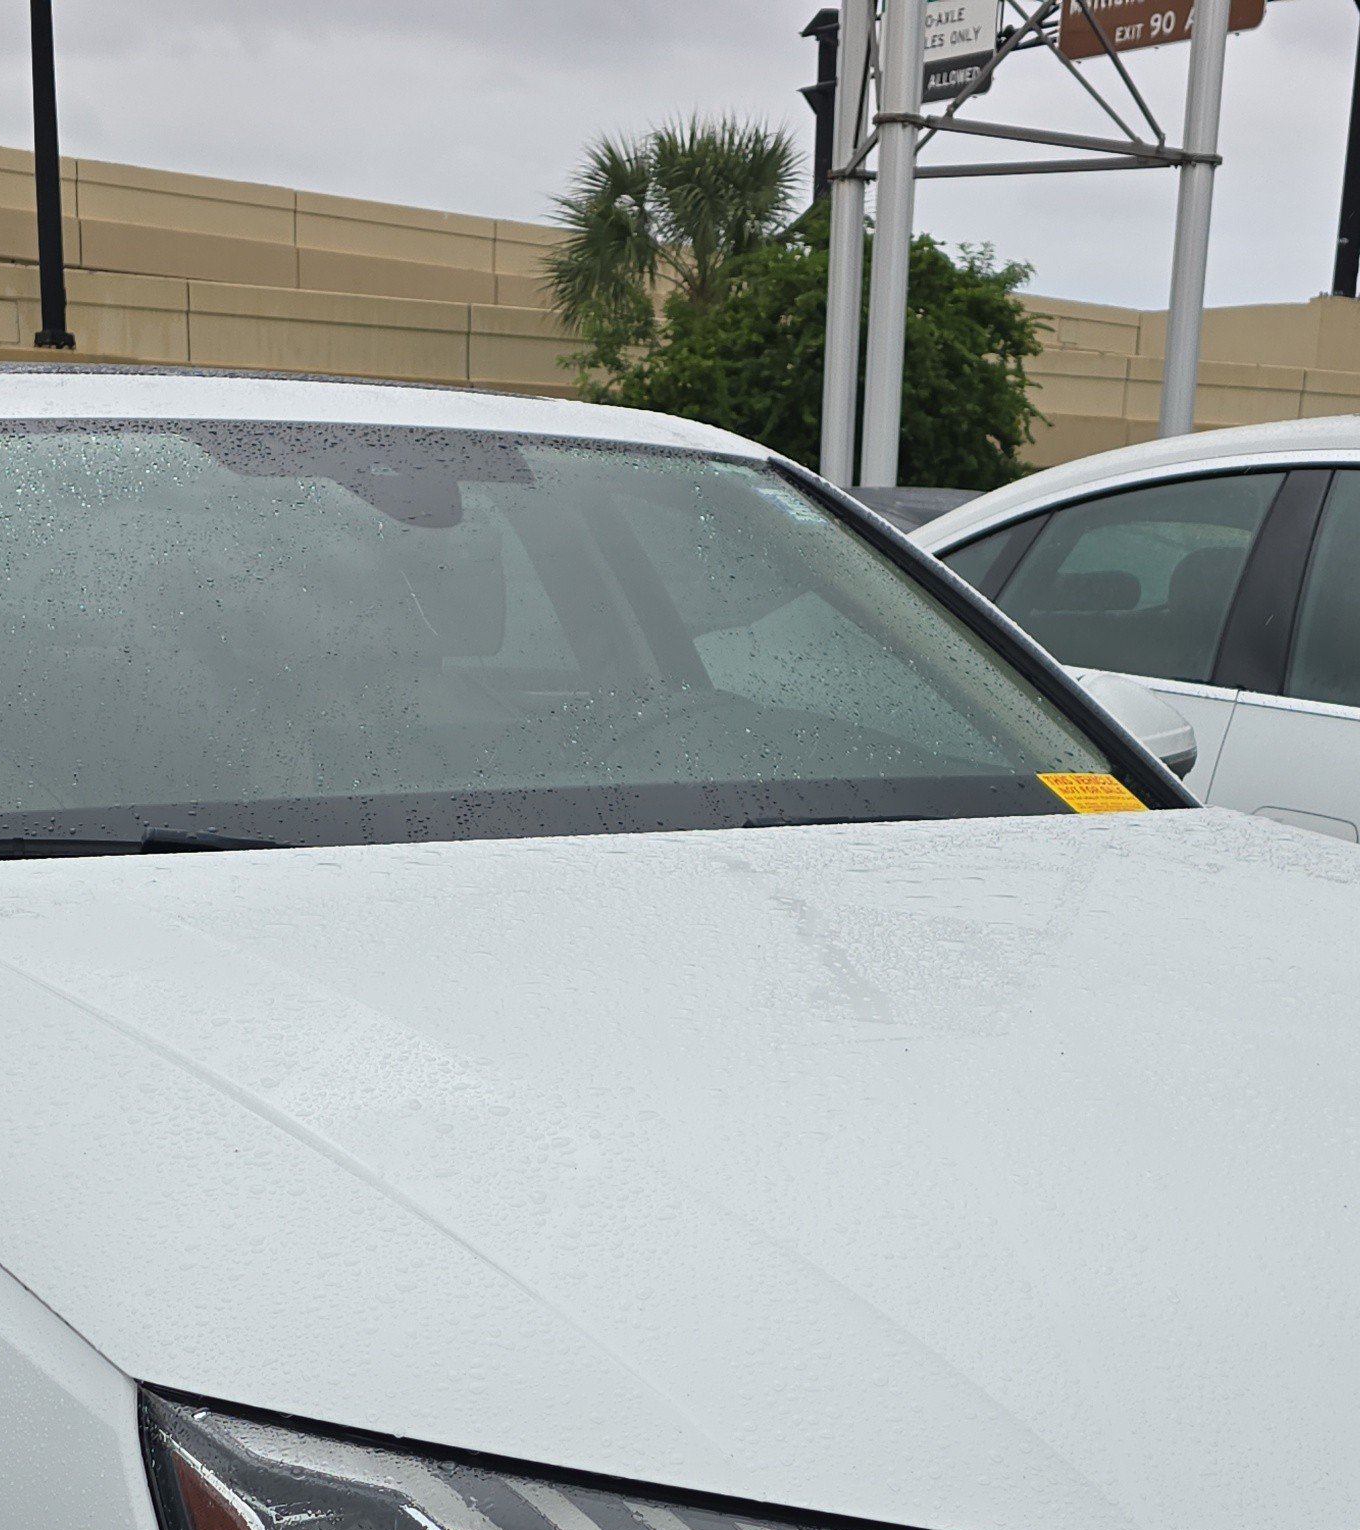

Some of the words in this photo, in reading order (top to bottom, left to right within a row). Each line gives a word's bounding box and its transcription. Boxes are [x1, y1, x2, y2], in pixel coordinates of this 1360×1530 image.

[925, 7, 965, 27] O-AXLE
[1115, 23, 1144, 43] EXIT
[1149, 10, 1176, 37] 90
[924, 33, 944, 49] LES
[949, 25, 982, 44] ONLY
